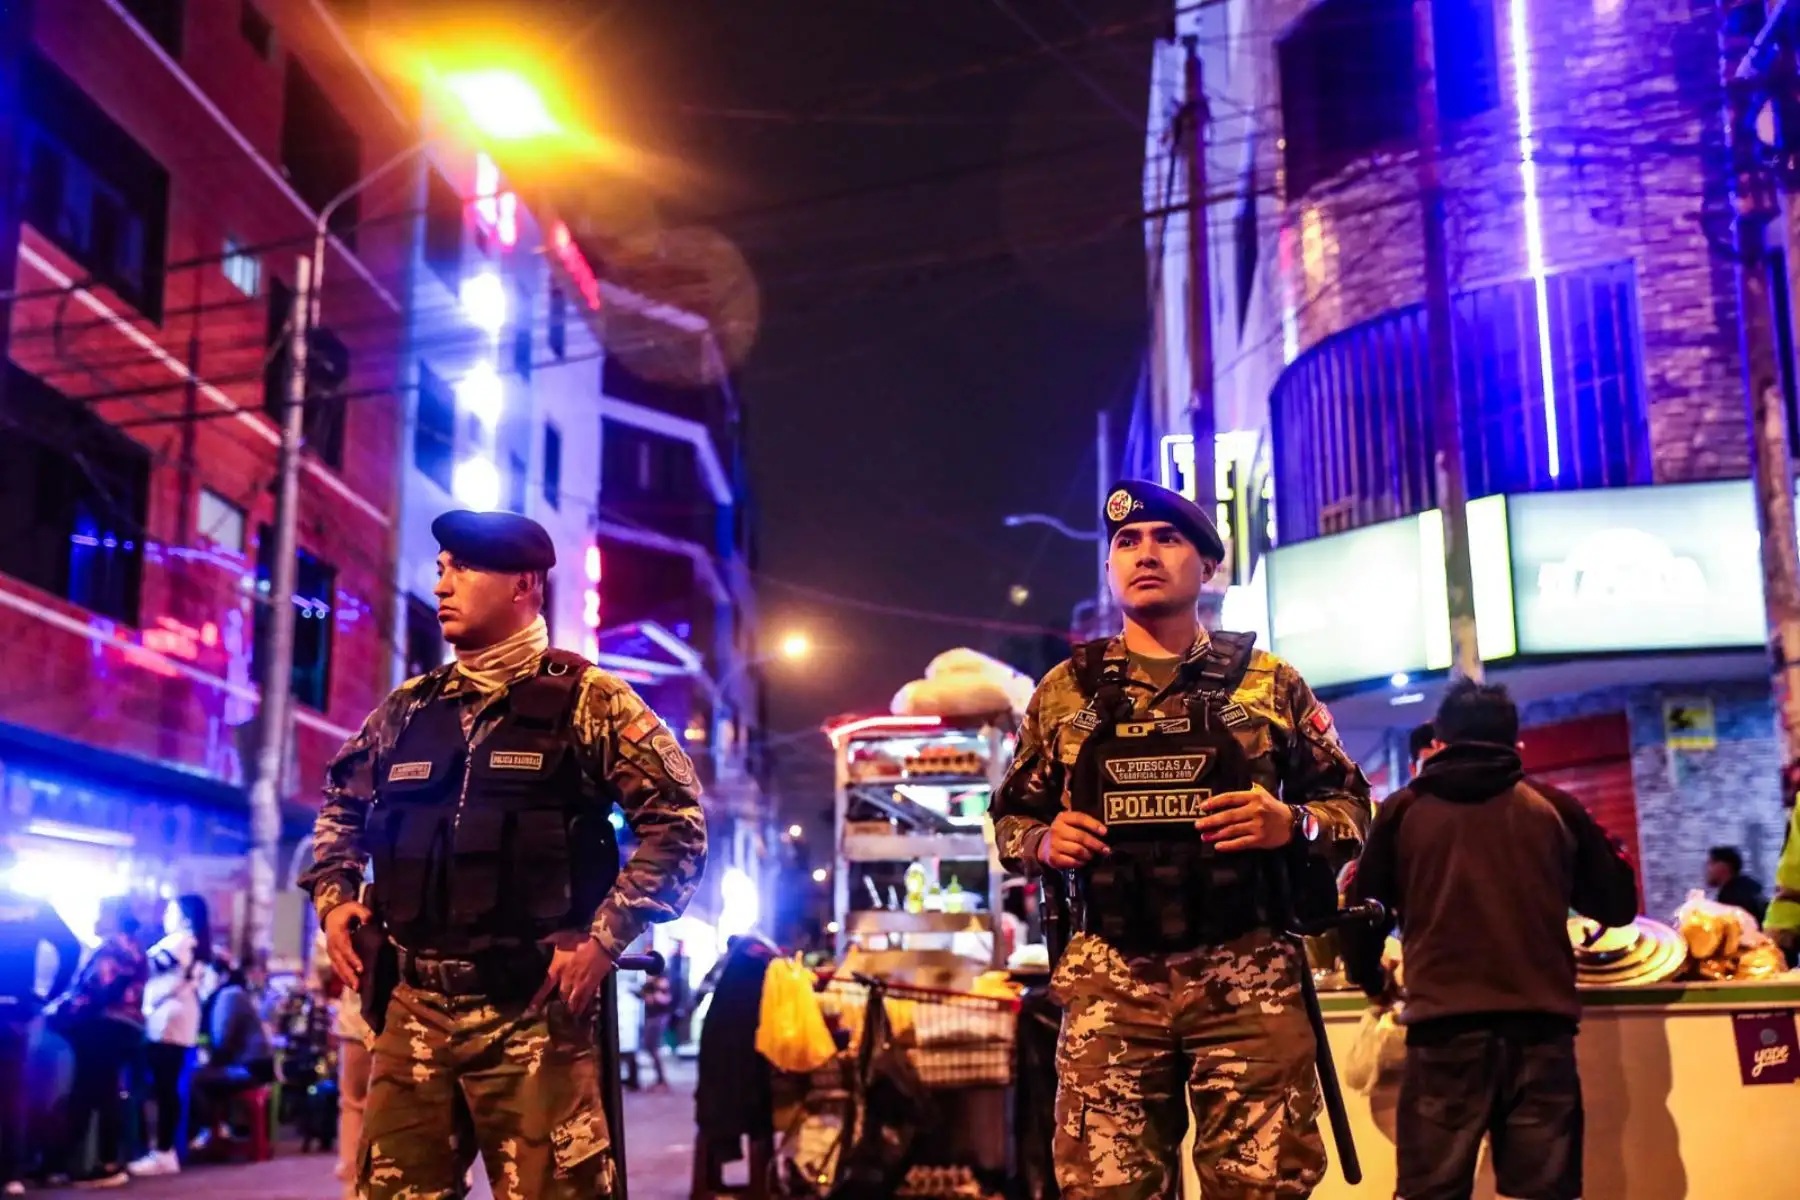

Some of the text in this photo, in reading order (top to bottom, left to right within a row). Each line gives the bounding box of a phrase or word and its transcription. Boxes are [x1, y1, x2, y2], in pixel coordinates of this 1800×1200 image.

[1127, 760, 1180, 772] PUESCAS
[1183, 759, 1195, 770] A.
[1109, 794, 1207, 819] POLICIA
[1751, 1044, 1790, 1078] yape
